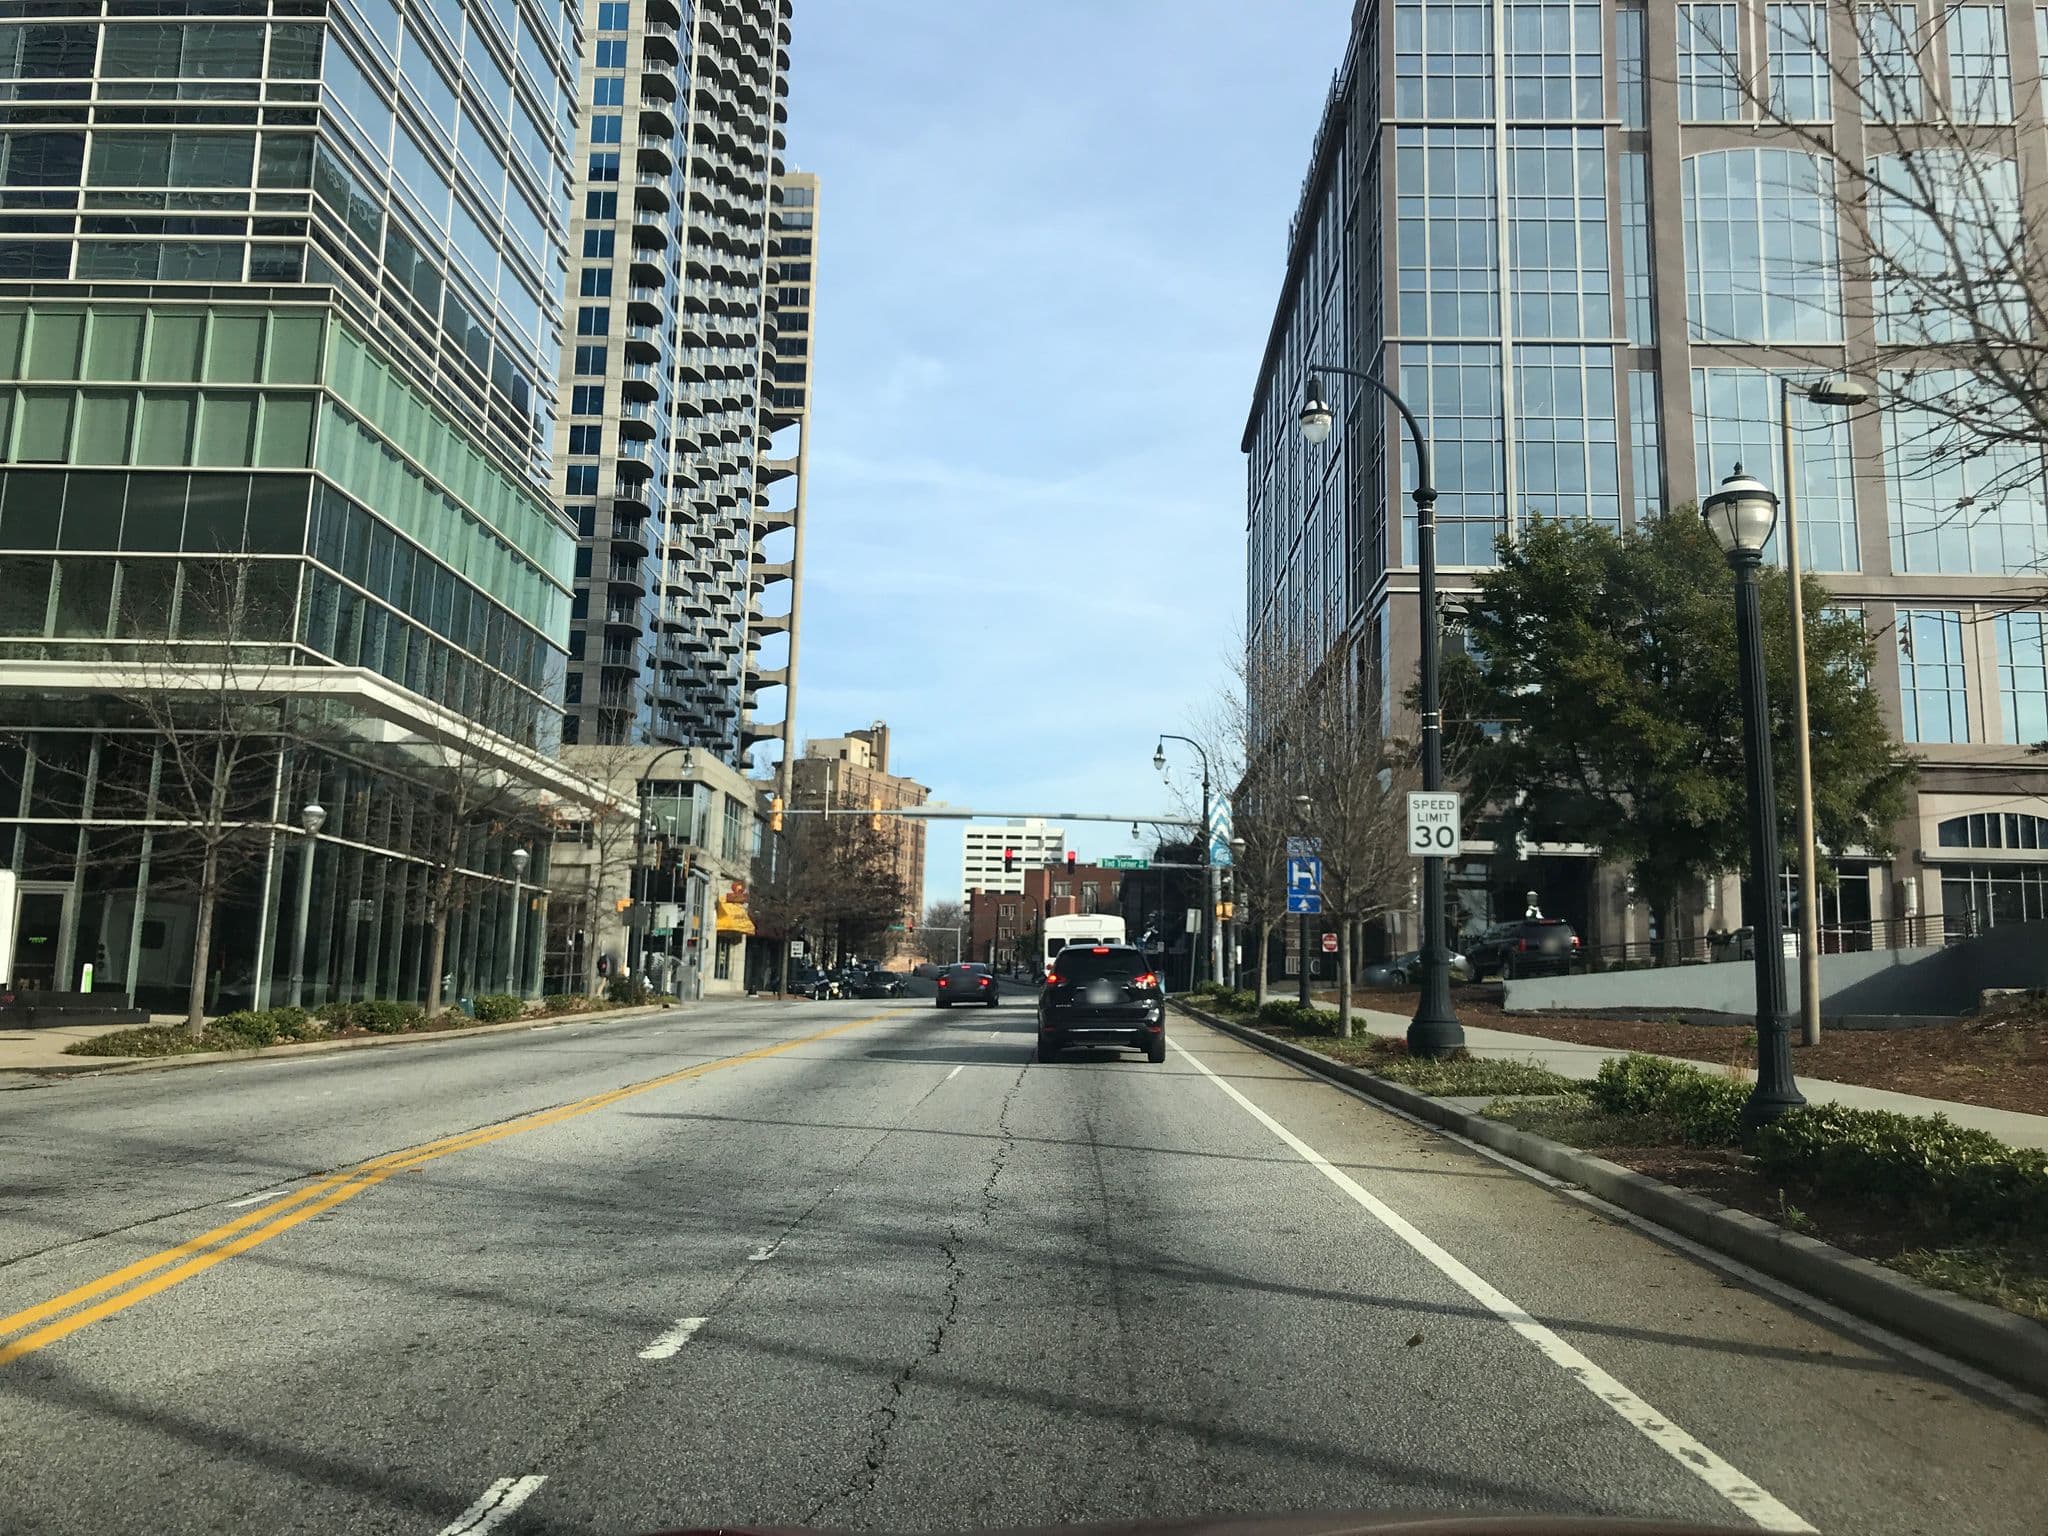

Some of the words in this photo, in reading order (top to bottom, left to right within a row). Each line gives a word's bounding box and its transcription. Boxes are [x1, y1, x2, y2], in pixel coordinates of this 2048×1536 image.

[1412, 800, 1455, 810] SPEED
[1417, 813, 1450, 822] LIMIT
[1414, 825, 1454, 848] 30
[1292, 861, 1316, 890] H
